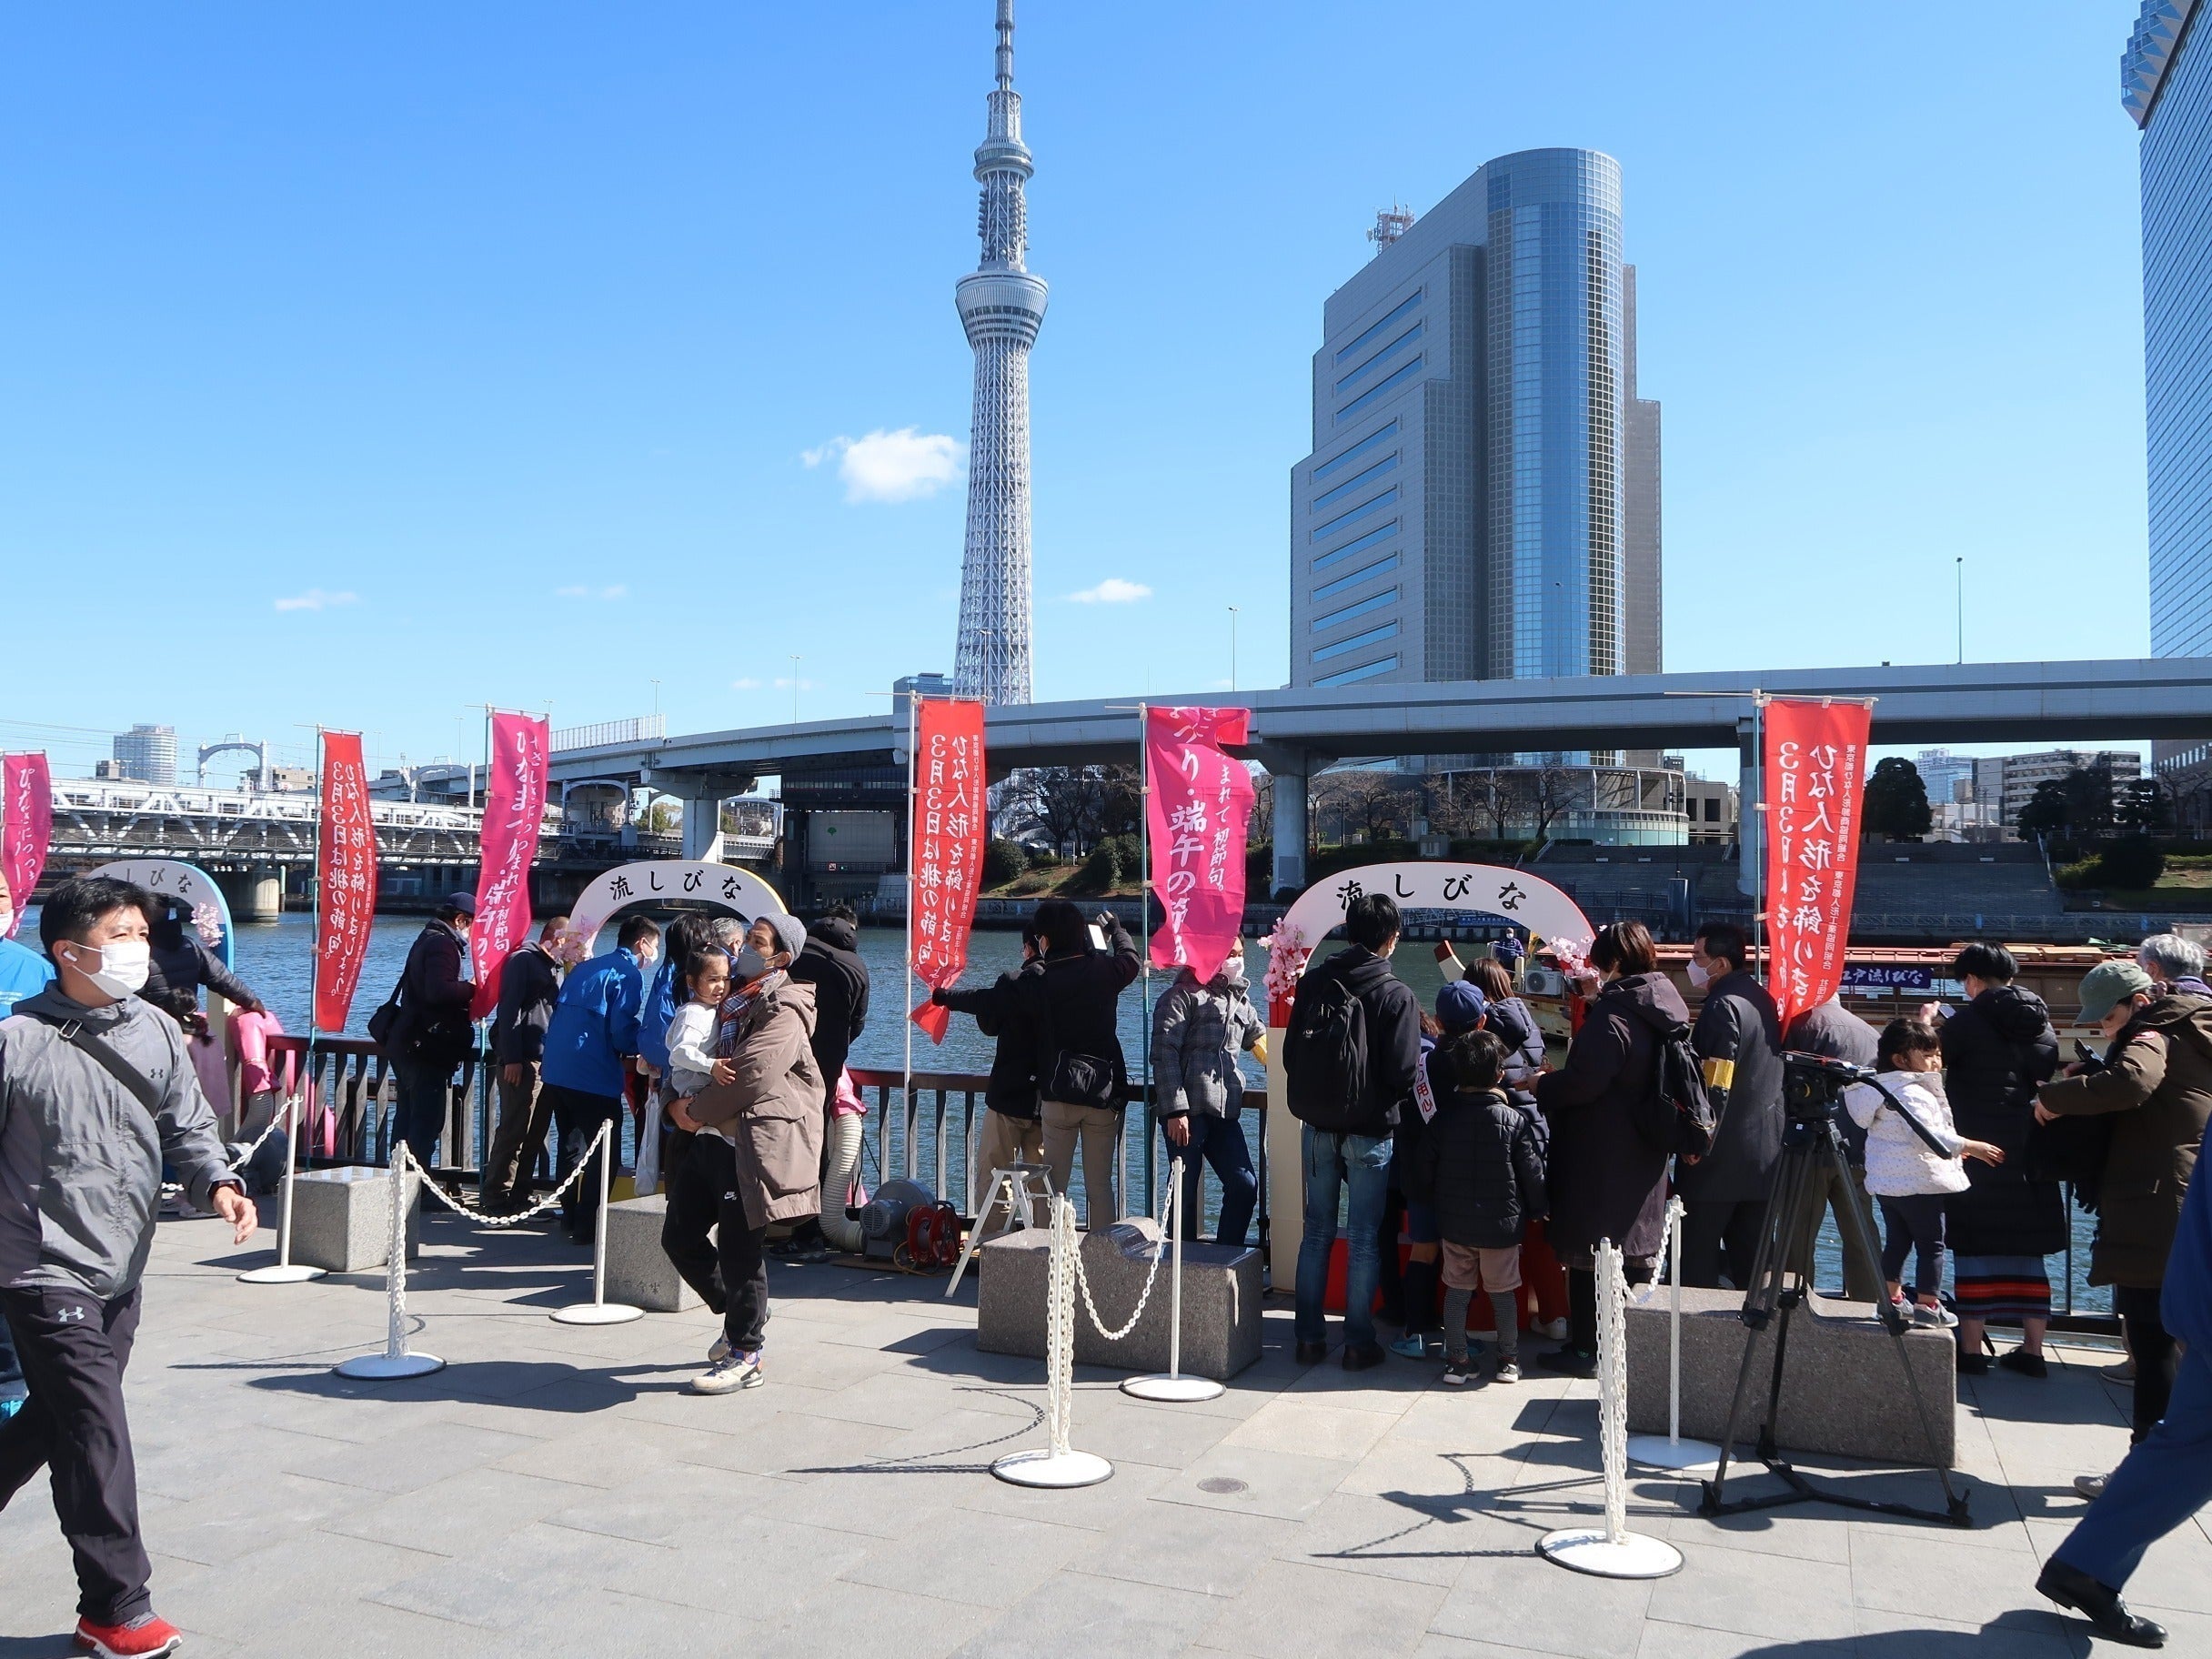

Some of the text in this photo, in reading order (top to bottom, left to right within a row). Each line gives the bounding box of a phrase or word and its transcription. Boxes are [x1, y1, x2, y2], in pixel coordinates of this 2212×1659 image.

[104, 868, 192, 894] しびな
[609, 870, 741, 900] 流しびな
[1336, 873, 1526, 910] 流しびな
